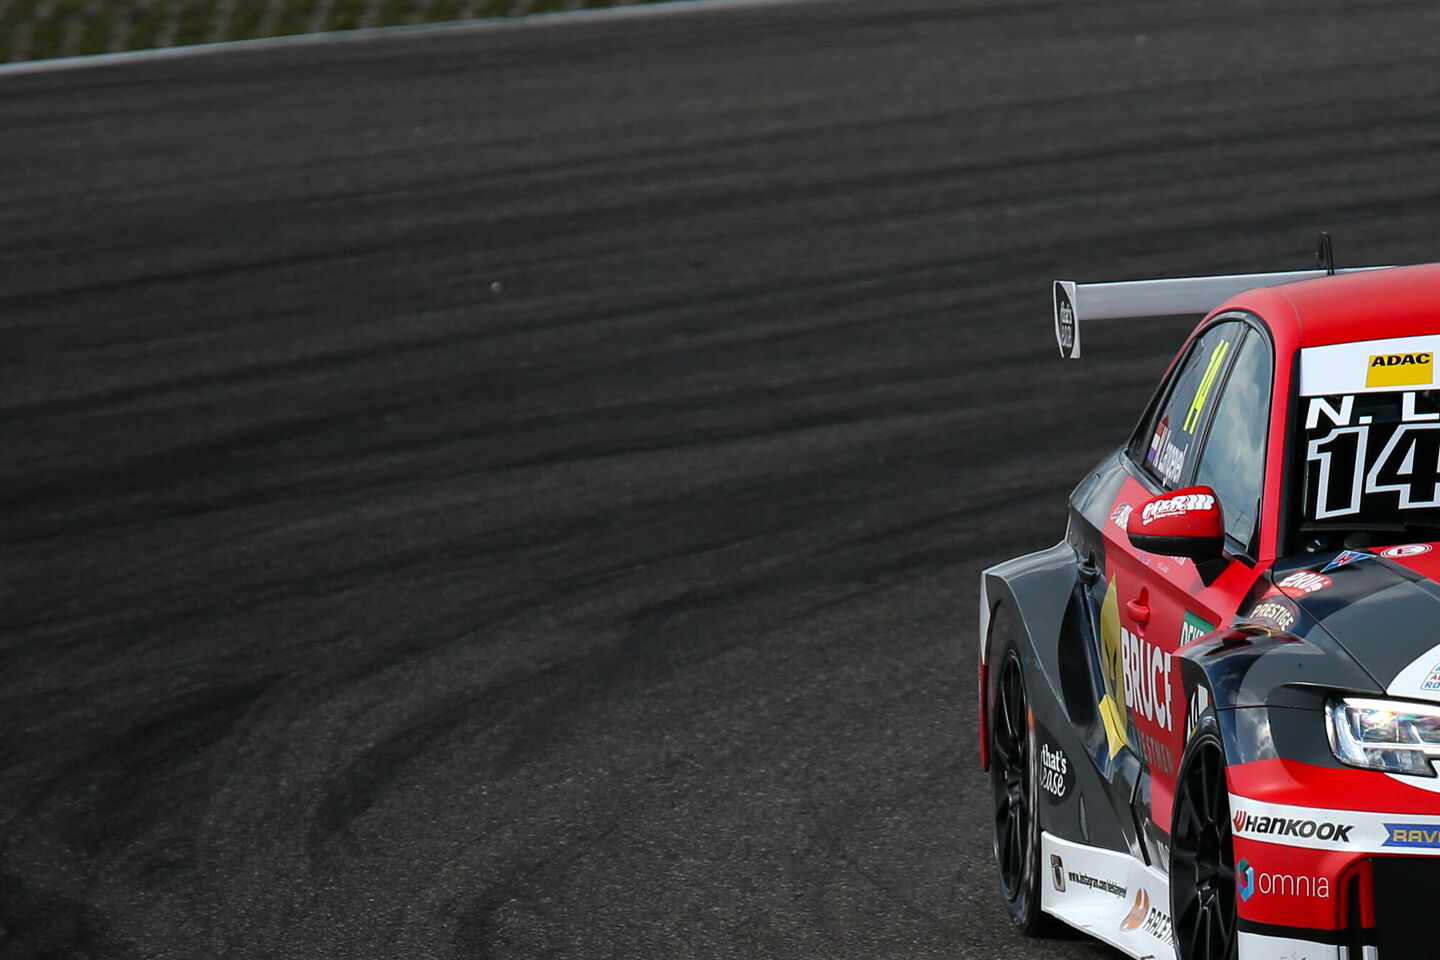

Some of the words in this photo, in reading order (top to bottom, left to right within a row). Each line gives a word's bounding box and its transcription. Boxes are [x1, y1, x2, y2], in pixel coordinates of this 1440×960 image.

[1370, 351, 1431, 368] ADAC
[1305, 397, 1373, 429] N.
[1250, 603, 1295, 631] PRESTIGE
[1258, 871, 1330, 898] omnia
